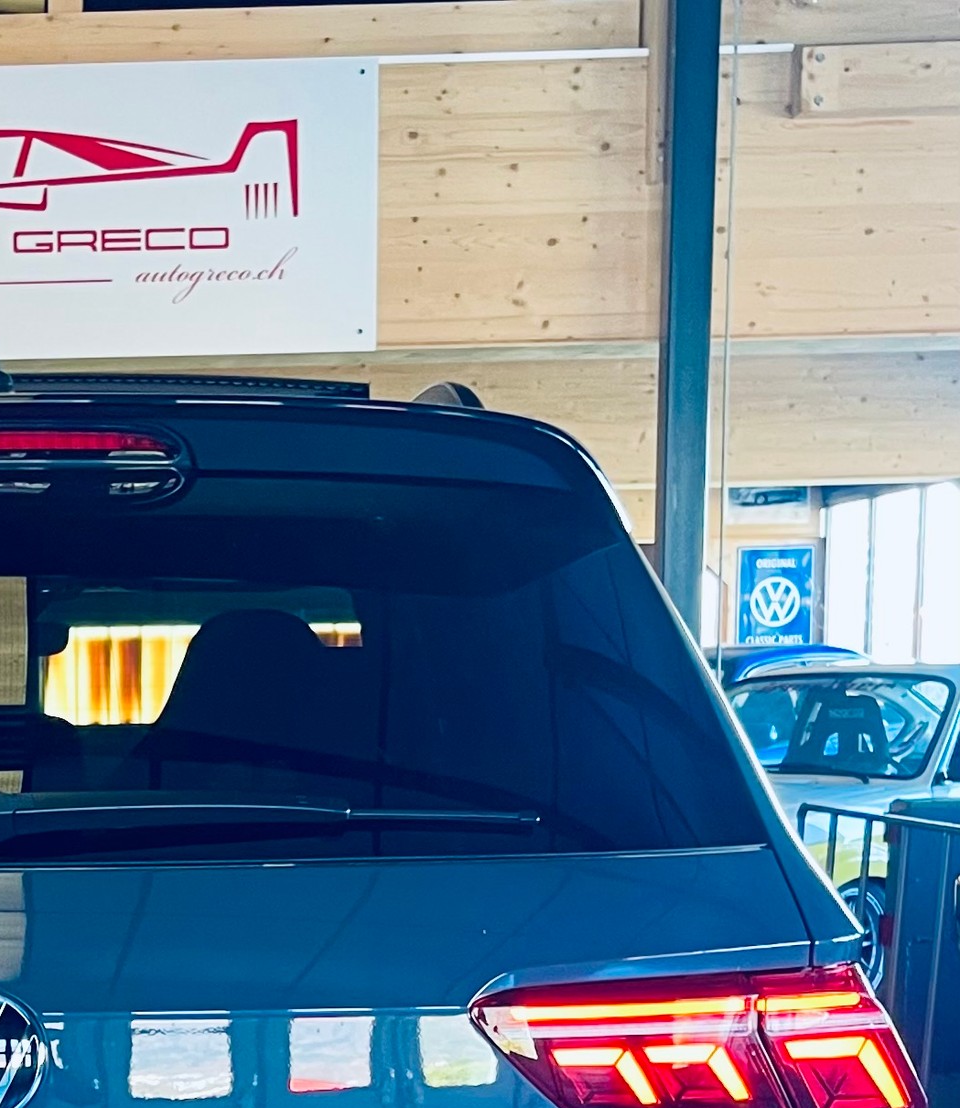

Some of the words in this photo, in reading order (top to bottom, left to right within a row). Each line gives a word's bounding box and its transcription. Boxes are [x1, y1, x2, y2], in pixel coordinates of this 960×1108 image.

[13, 227, 229, 253] GRECO
[135, 246, 298, 304] autogreco.ch
[756, 558, 797, 569] ORIGINAL
[745, 635, 777, 644] CLASSIC
[779, 634, 803, 644] PARTS
